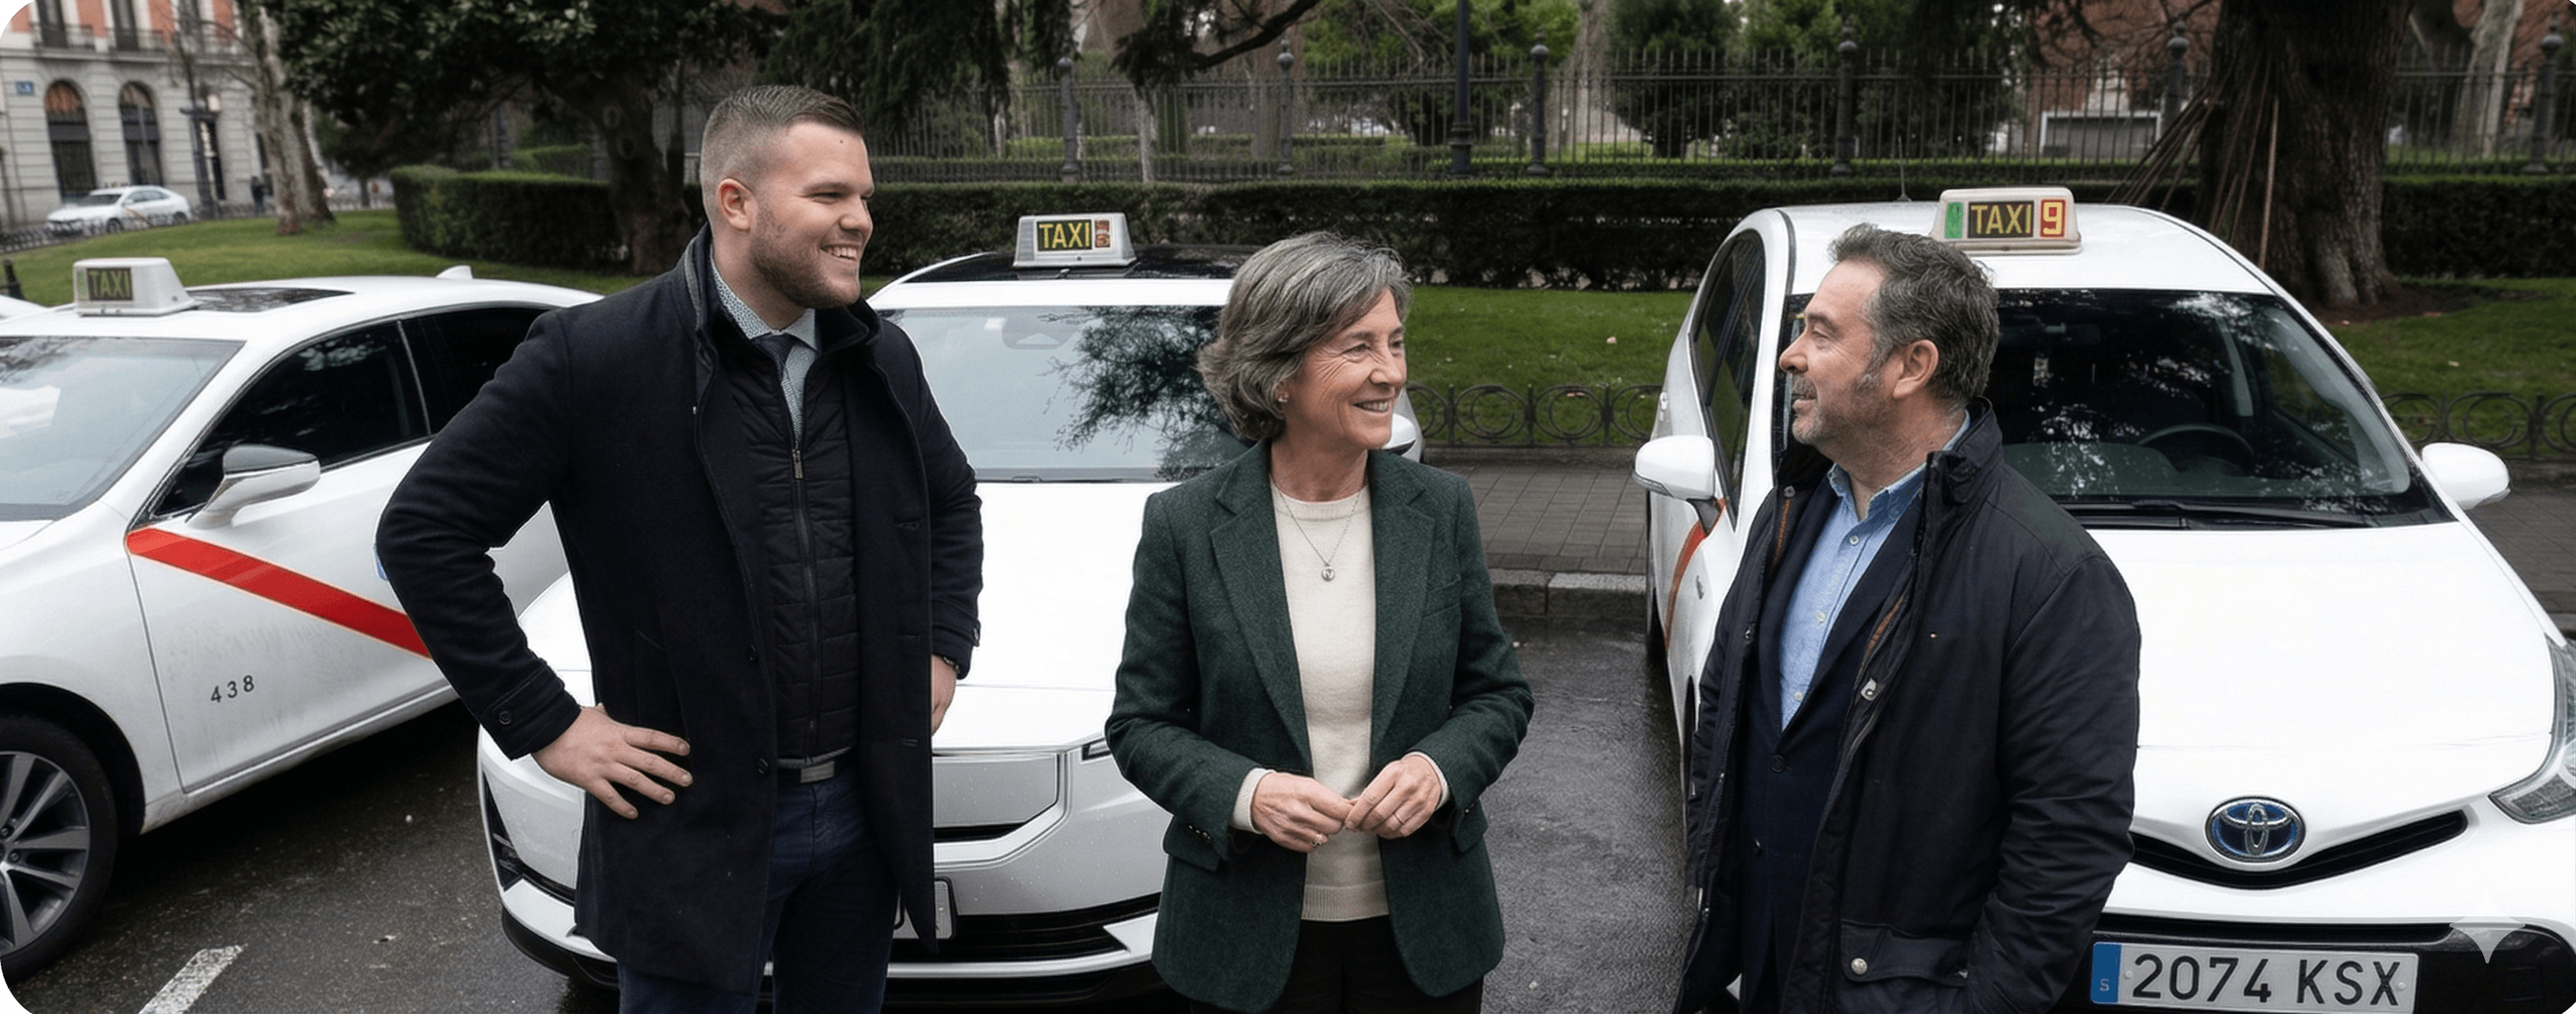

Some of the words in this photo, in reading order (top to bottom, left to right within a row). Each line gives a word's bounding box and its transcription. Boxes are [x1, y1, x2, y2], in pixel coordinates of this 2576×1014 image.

[1971, 204, 2032, 234] TAXI
[2043, 202, 2063, 234] 9
[1038, 223, 1090, 248] TAXI
[89, 270, 131, 299] TAXI
[211, 675, 254, 703] 438
[2132, 953, 2272, 1003] 2074
[2296, 959, 2401, 1006] KSX
